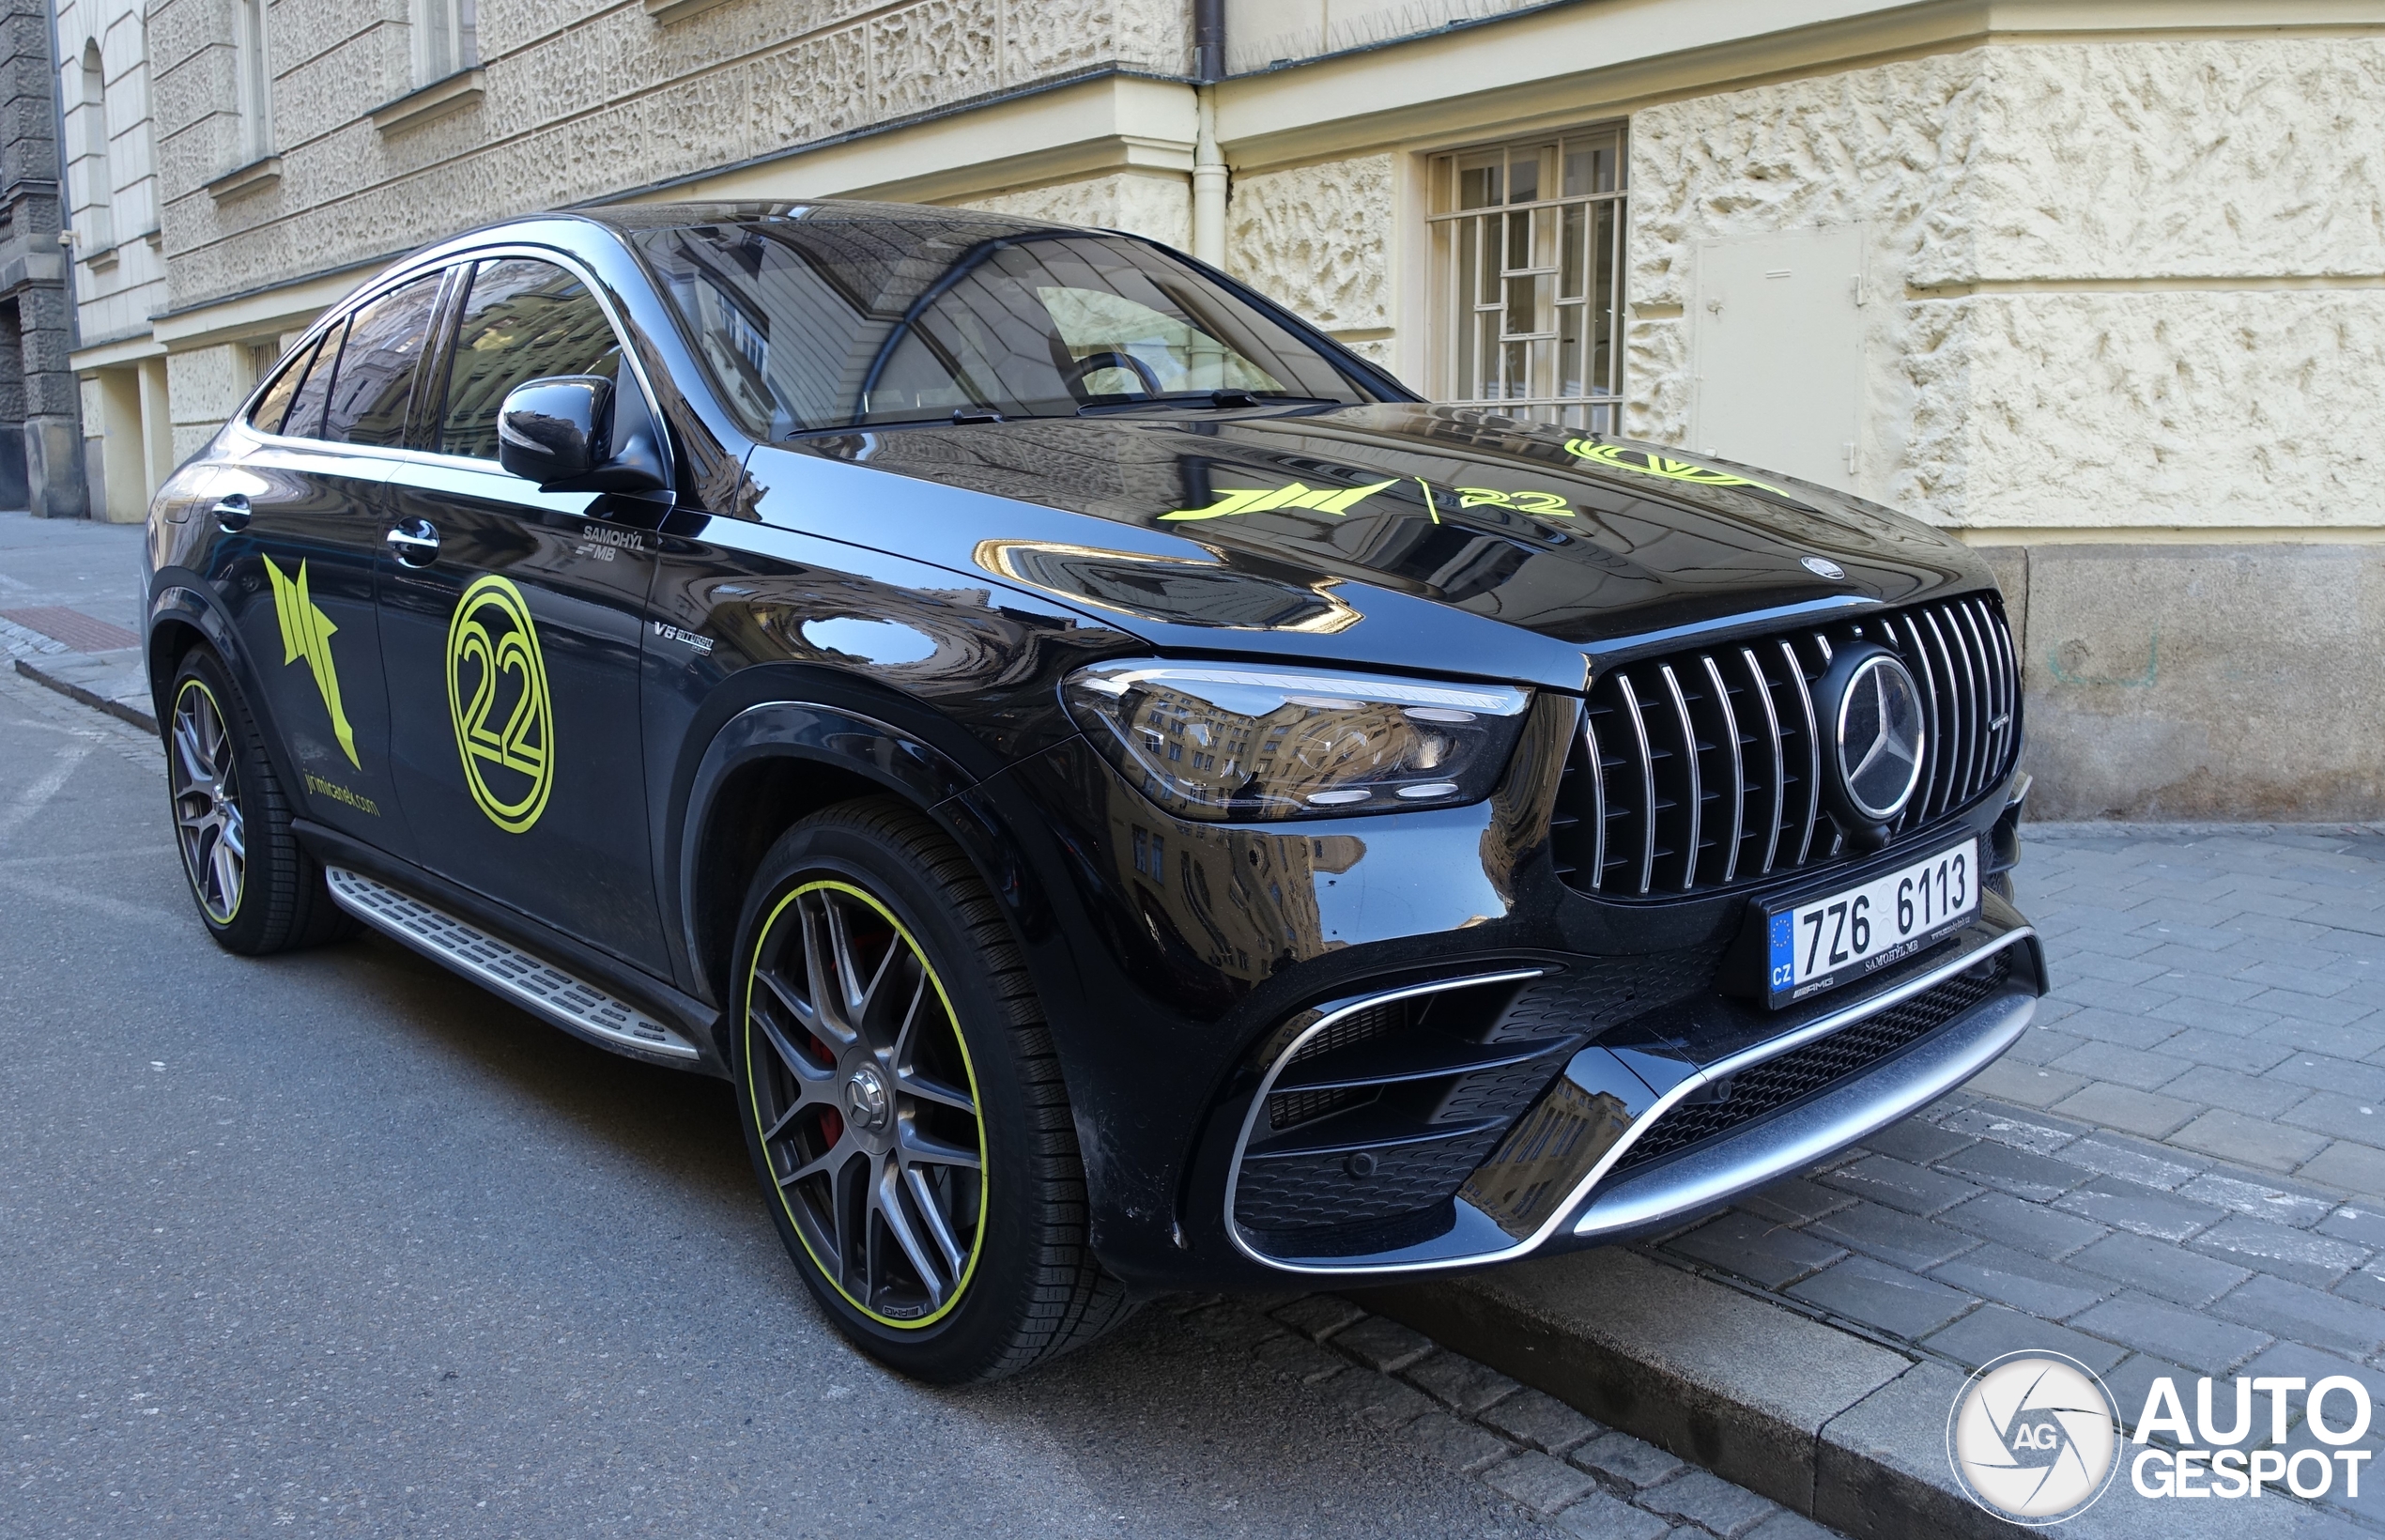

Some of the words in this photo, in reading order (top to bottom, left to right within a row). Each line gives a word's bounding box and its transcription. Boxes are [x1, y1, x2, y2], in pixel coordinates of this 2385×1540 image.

[583, 525, 644, 551] SAMOHÝL
[593, 546, 616, 562] MB
[457, 621, 543, 778] 22
[1803, 894, 1870, 977] 7Z6
[1897, 853, 1966, 935] 6113
[1772, 962, 1792, 986] CZ
